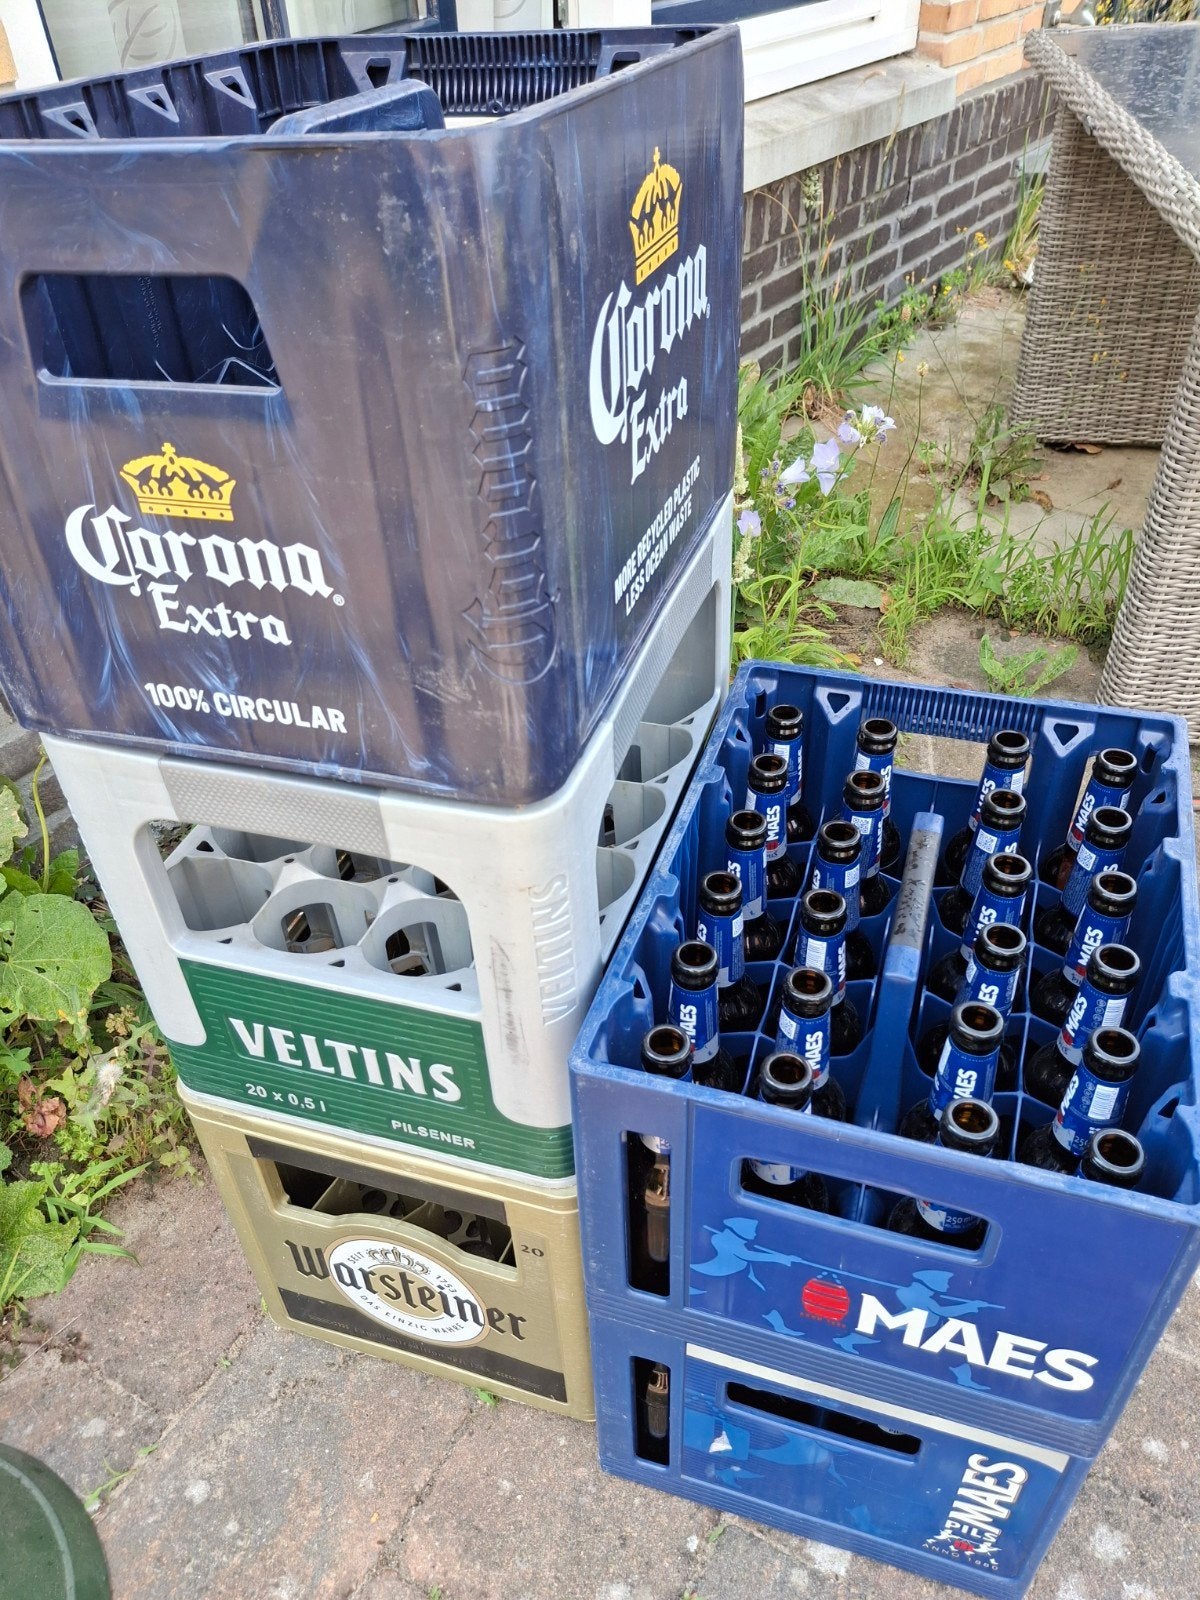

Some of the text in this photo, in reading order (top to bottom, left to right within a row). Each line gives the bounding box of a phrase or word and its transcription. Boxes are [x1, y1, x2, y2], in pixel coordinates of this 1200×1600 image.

[590, 244, 707, 446] Corona
[630, 376, 688, 485] Extra
[65, 503, 335, 599] Corona
[614, 455, 700, 604] MORE RECYCLED PLASTIC
[626, 493, 692, 616] LESS OCEAN WASTE
[147, 581, 293, 646] Extra
[144, 682, 348, 734] 100% CIRCULAR
[766, 804, 781, 842] MAES
[228, 1017, 462, 1102] VELTINS
[245, 1083, 268, 1099] 20
[390, 1119, 476, 1149] PILSENER
[346, 1251, 458, 1294] SEIT 1753
[520, 1244, 545, 1257] 20
[284, 1239, 528, 1342] Warsteiner
[360, 1294, 465, 1335] DAS EINZIG WAHRE
[855, 1292, 1100, 1391] MAES
[948, 1453, 1029, 1536] MAES
[922, 1543, 960, 1558] ANNO
[944, 1519, 999, 1543] PILS
